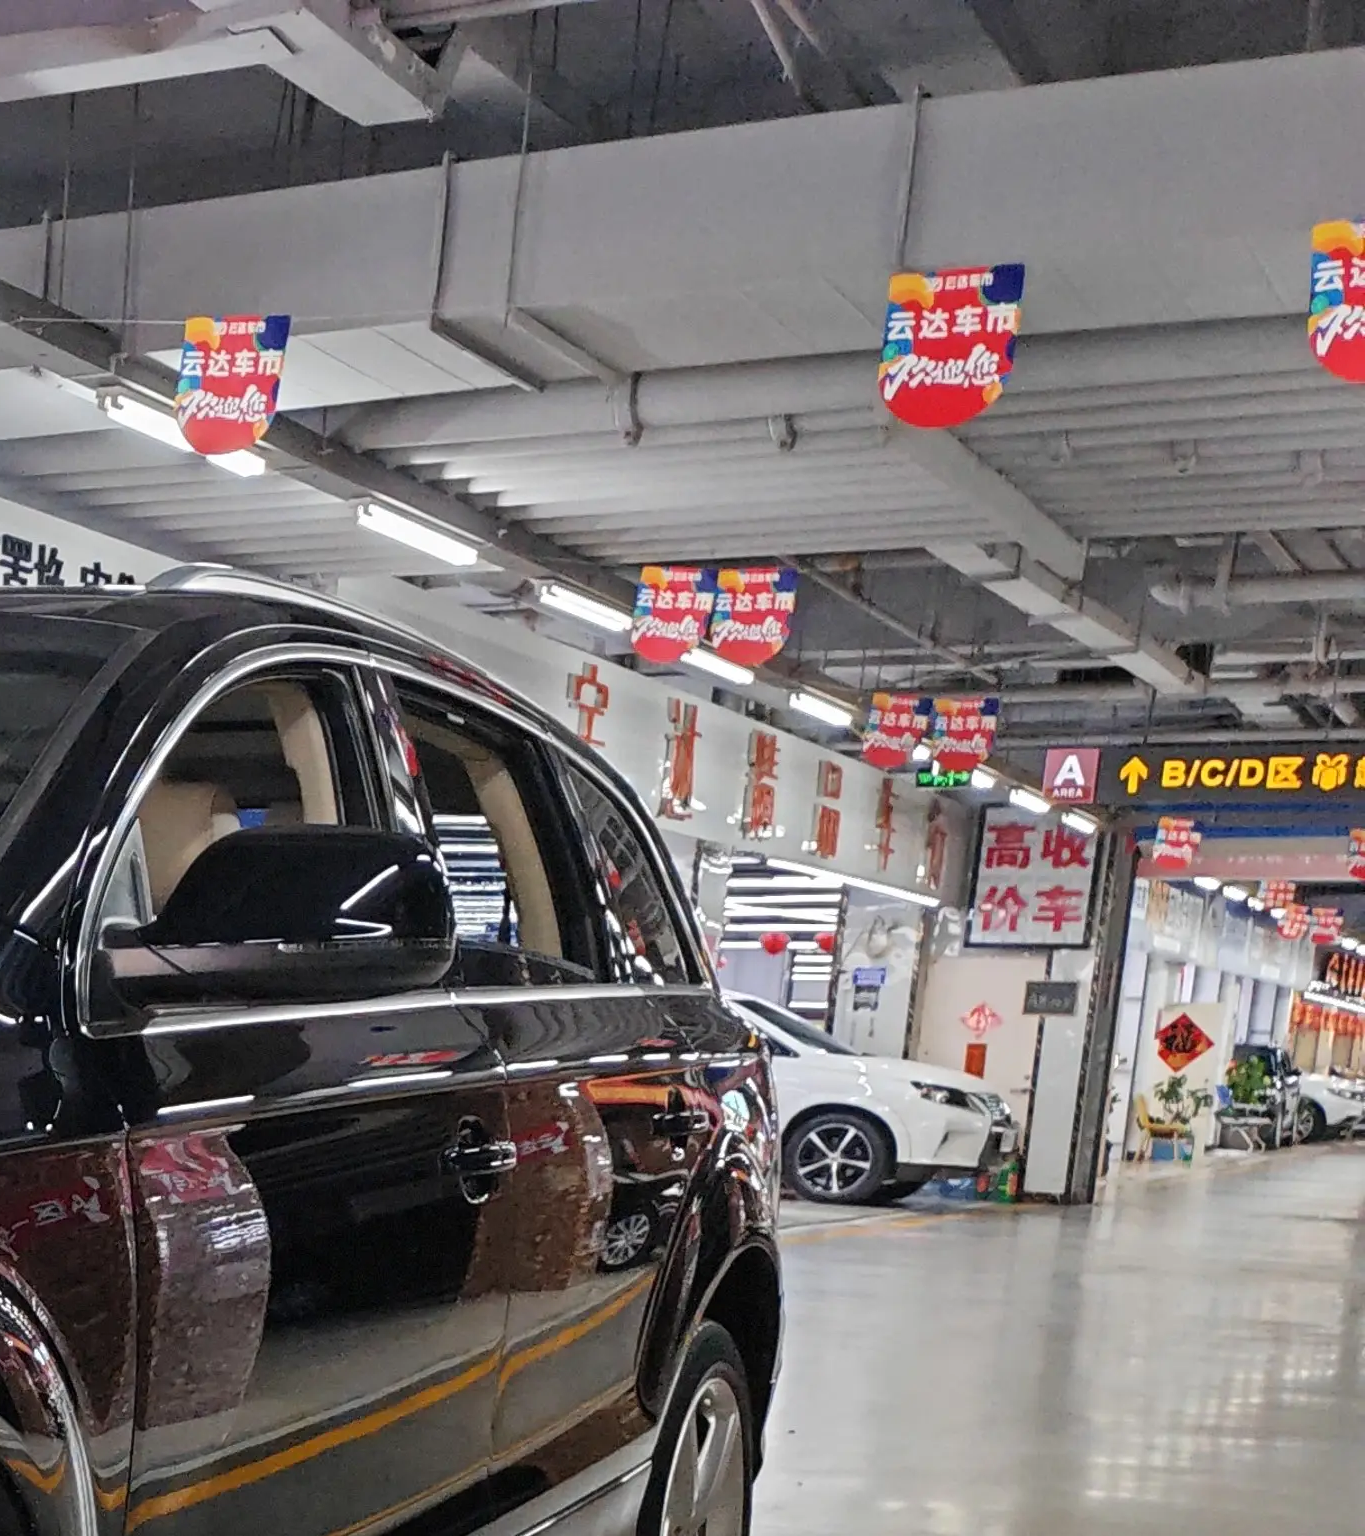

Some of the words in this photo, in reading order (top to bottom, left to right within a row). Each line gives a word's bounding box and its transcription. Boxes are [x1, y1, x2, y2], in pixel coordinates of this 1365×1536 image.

[887, 303, 1018, 341] 云达车市
[182, 348, 283, 377] 云达车市
[1054, 755, 1085, 787] A
[1161, 756, 1306, 790] B/C/D区
[1052, 788, 1083, 798] AREA
